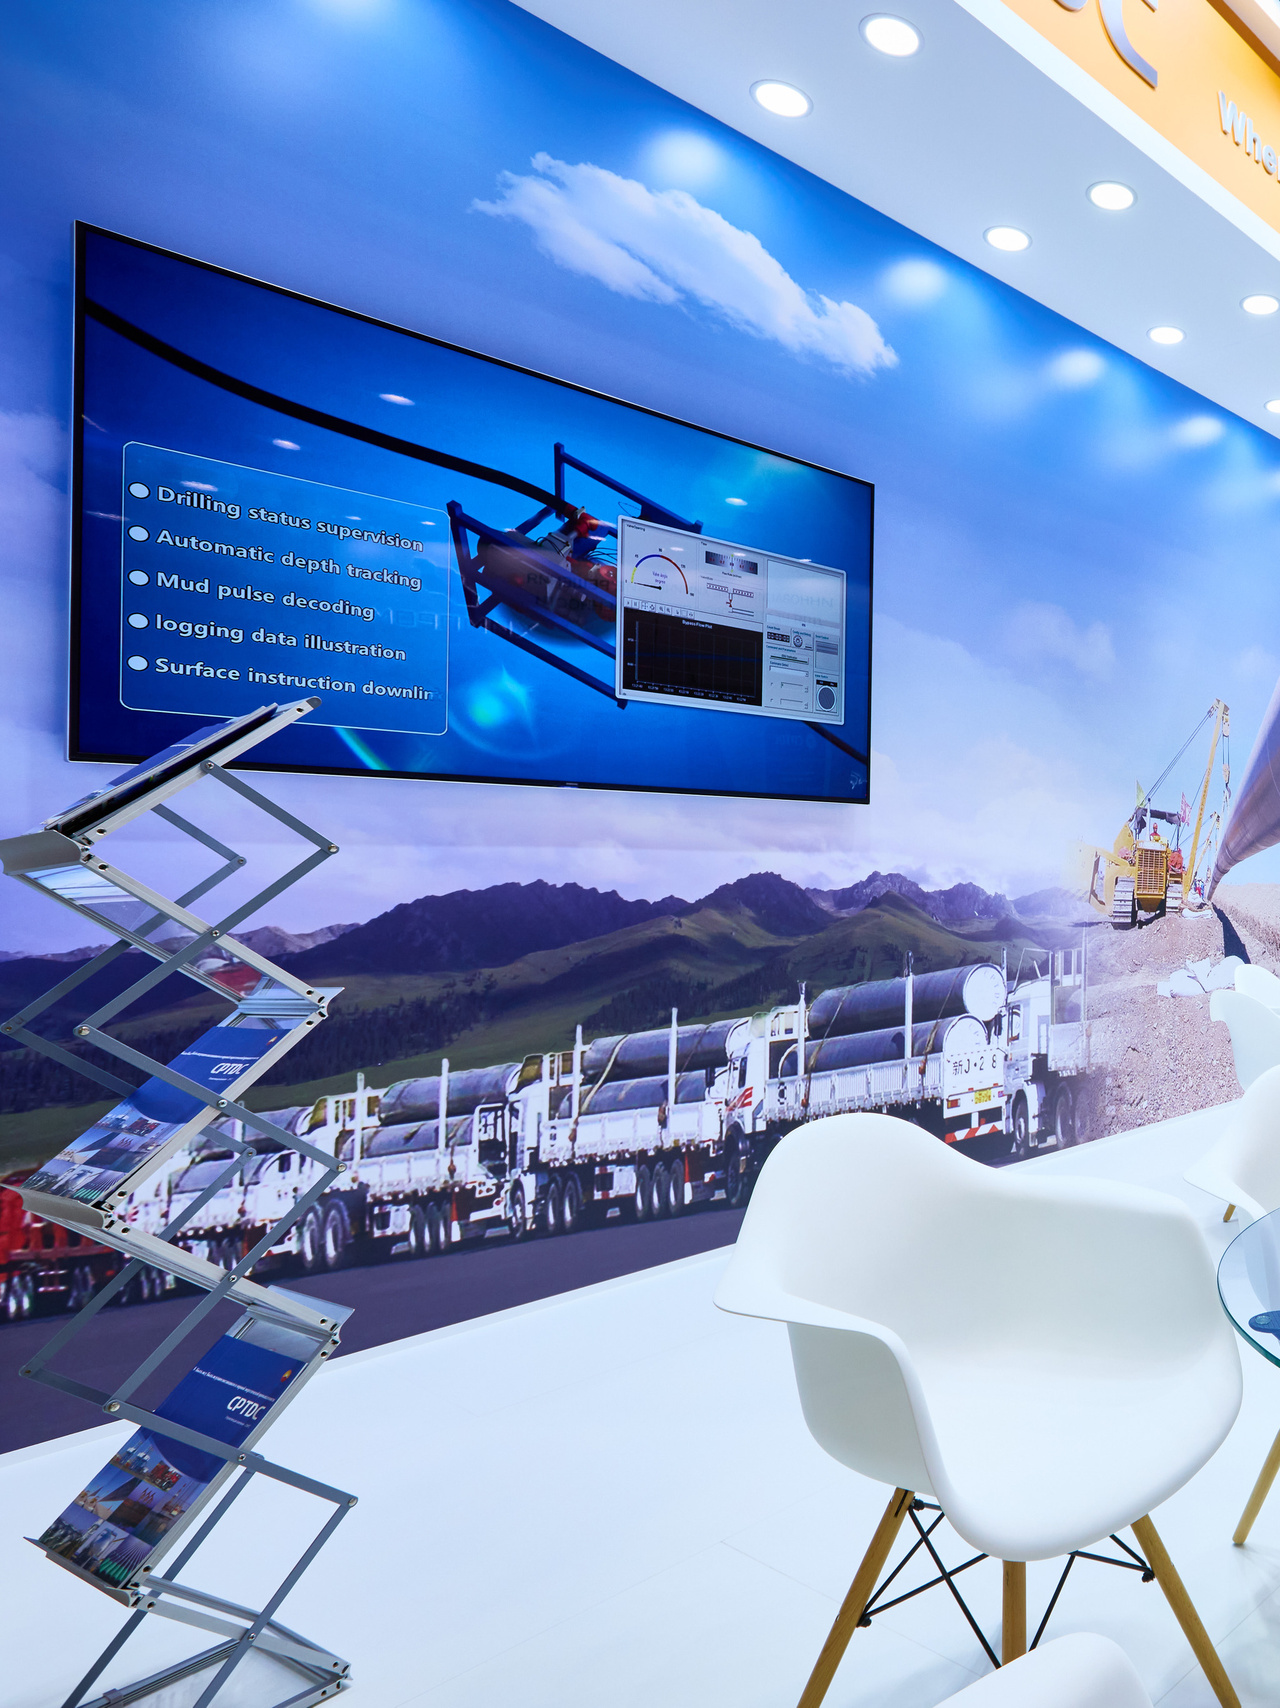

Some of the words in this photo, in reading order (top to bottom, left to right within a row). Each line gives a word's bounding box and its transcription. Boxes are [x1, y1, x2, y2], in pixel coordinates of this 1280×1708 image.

[157, 486, 241, 519] Drilling
[248, 507, 312, 530] status
[316, 520, 424, 553] supervision
[155, 529, 275, 564] Automatic
[280, 551, 341, 575] depth
[345, 562, 422, 592] tracking
[156, 571, 210, 594] Mud
[217, 584, 275, 604] pulse
[282, 591, 375, 622] decoding
[155, 614, 245, 644] logging
[251, 627, 297, 647] data
[303, 634, 407, 661] illustration
[154, 657, 241, 681] Surface
[248, 667, 356, 694] instruction
[210, 1062, 250, 1075] CPTDC
[226, 1396, 266, 1421] CPTDC
